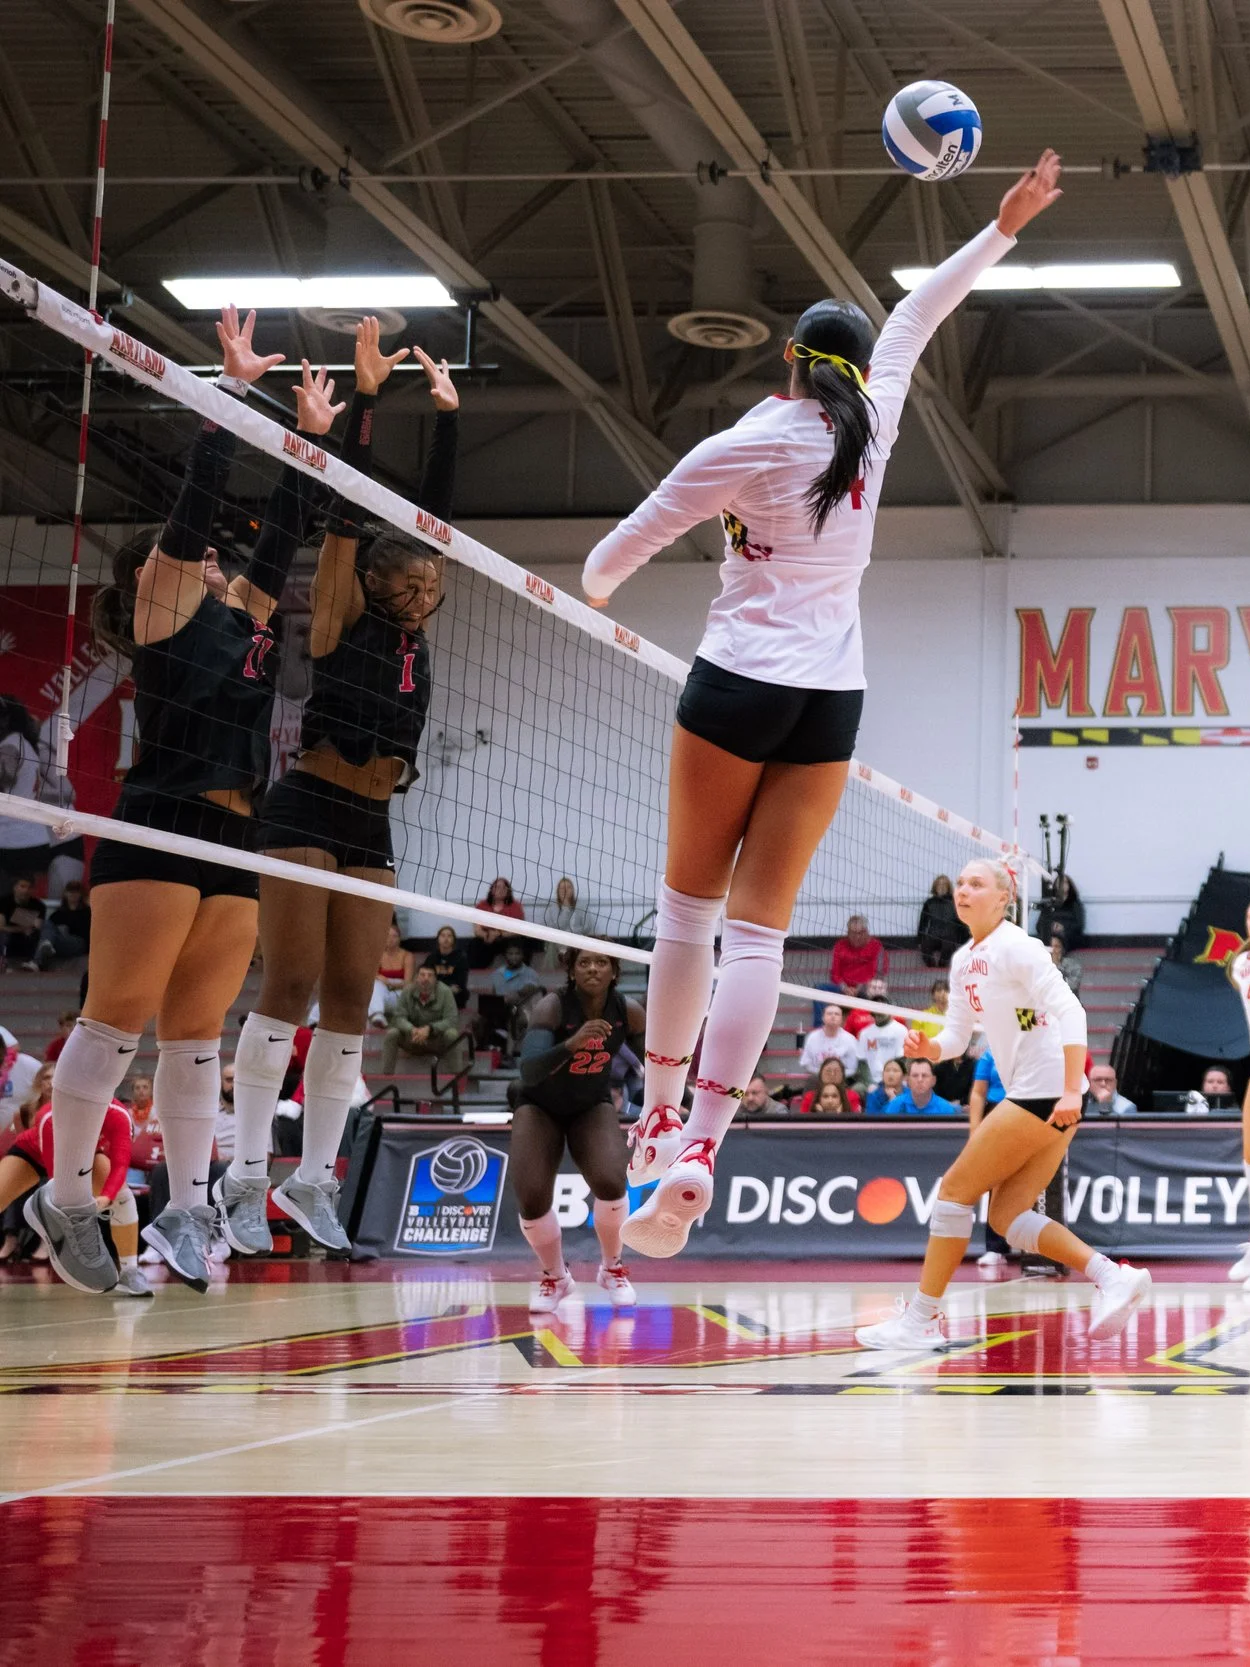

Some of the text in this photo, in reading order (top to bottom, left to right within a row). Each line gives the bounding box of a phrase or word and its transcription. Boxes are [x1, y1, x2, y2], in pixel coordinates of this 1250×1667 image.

[924, 144, 958, 180] molten
[0, 264, 17, 279] enoh
[112, 329, 166, 376] MARYLAND
[283, 430, 328, 469] MARYLAND
[416, 508, 453, 544] MARYLAND
[399, 653, 416, 692] 1
[569, 1051, 611, 1075] 22
[441, 1205, 491, 1217] DISCOVER
[726, 1175, 989, 1226] DISCOV
[403, 1228, 489, 1242] CHALLENGE
[407, 1217, 490, 1227] VOLLEYBALL
